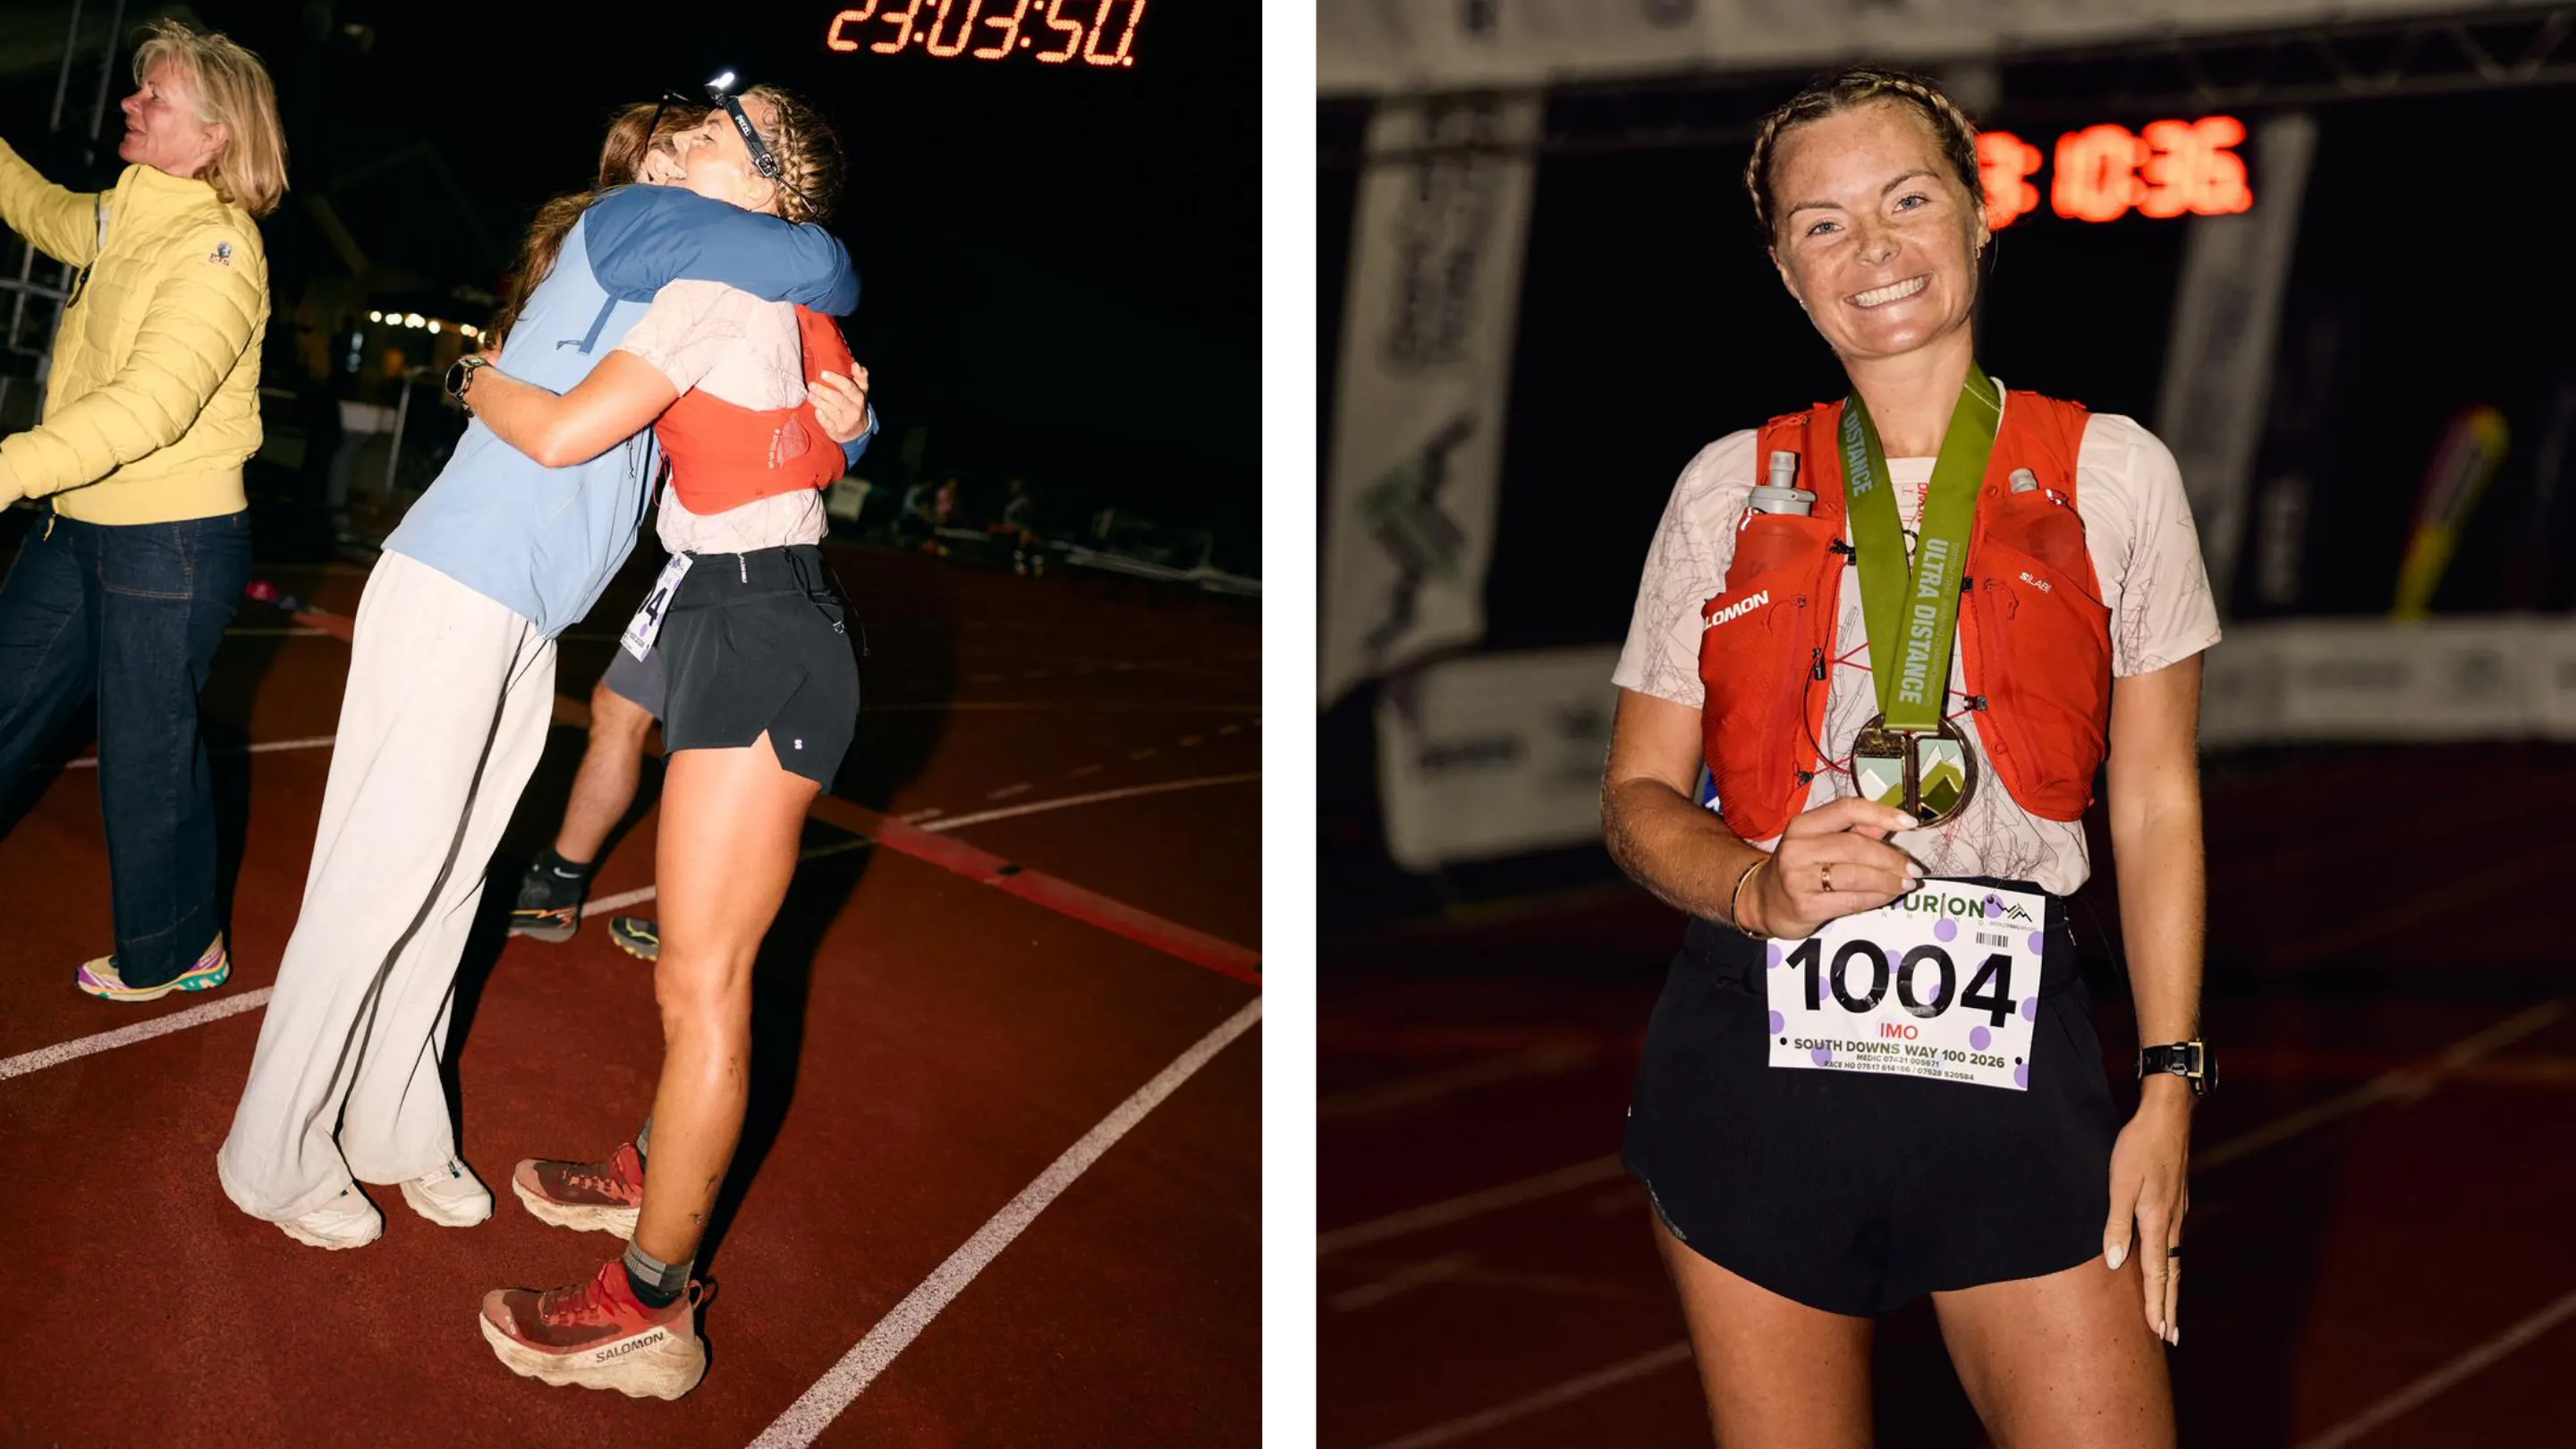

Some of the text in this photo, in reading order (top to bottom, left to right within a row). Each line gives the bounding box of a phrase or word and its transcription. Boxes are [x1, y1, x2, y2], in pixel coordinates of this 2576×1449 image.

[1975, 115, 2254, 232] 3:10:36
[1843, 410, 1873, 497] DISTANCE
[638, 586, 667, 627] 4
[1703, 589, 1769, 630] LOMON
[1898, 538, 1950, 706] ULTRA DISTANCE
[1889, 892, 1986, 920] URION
[1785, 937, 2017, 1029] 1004
[1880, 1022, 1919, 1040] IMO
[1793, 1038, 2005, 1069] SOUTH DOWNS WAY 100 2026
[1825, 1059, 1843, 1069] RACE
[1856, 1054, 1883, 1063] MEDIC
[595, 1332, 664, 1364] SALOMON
